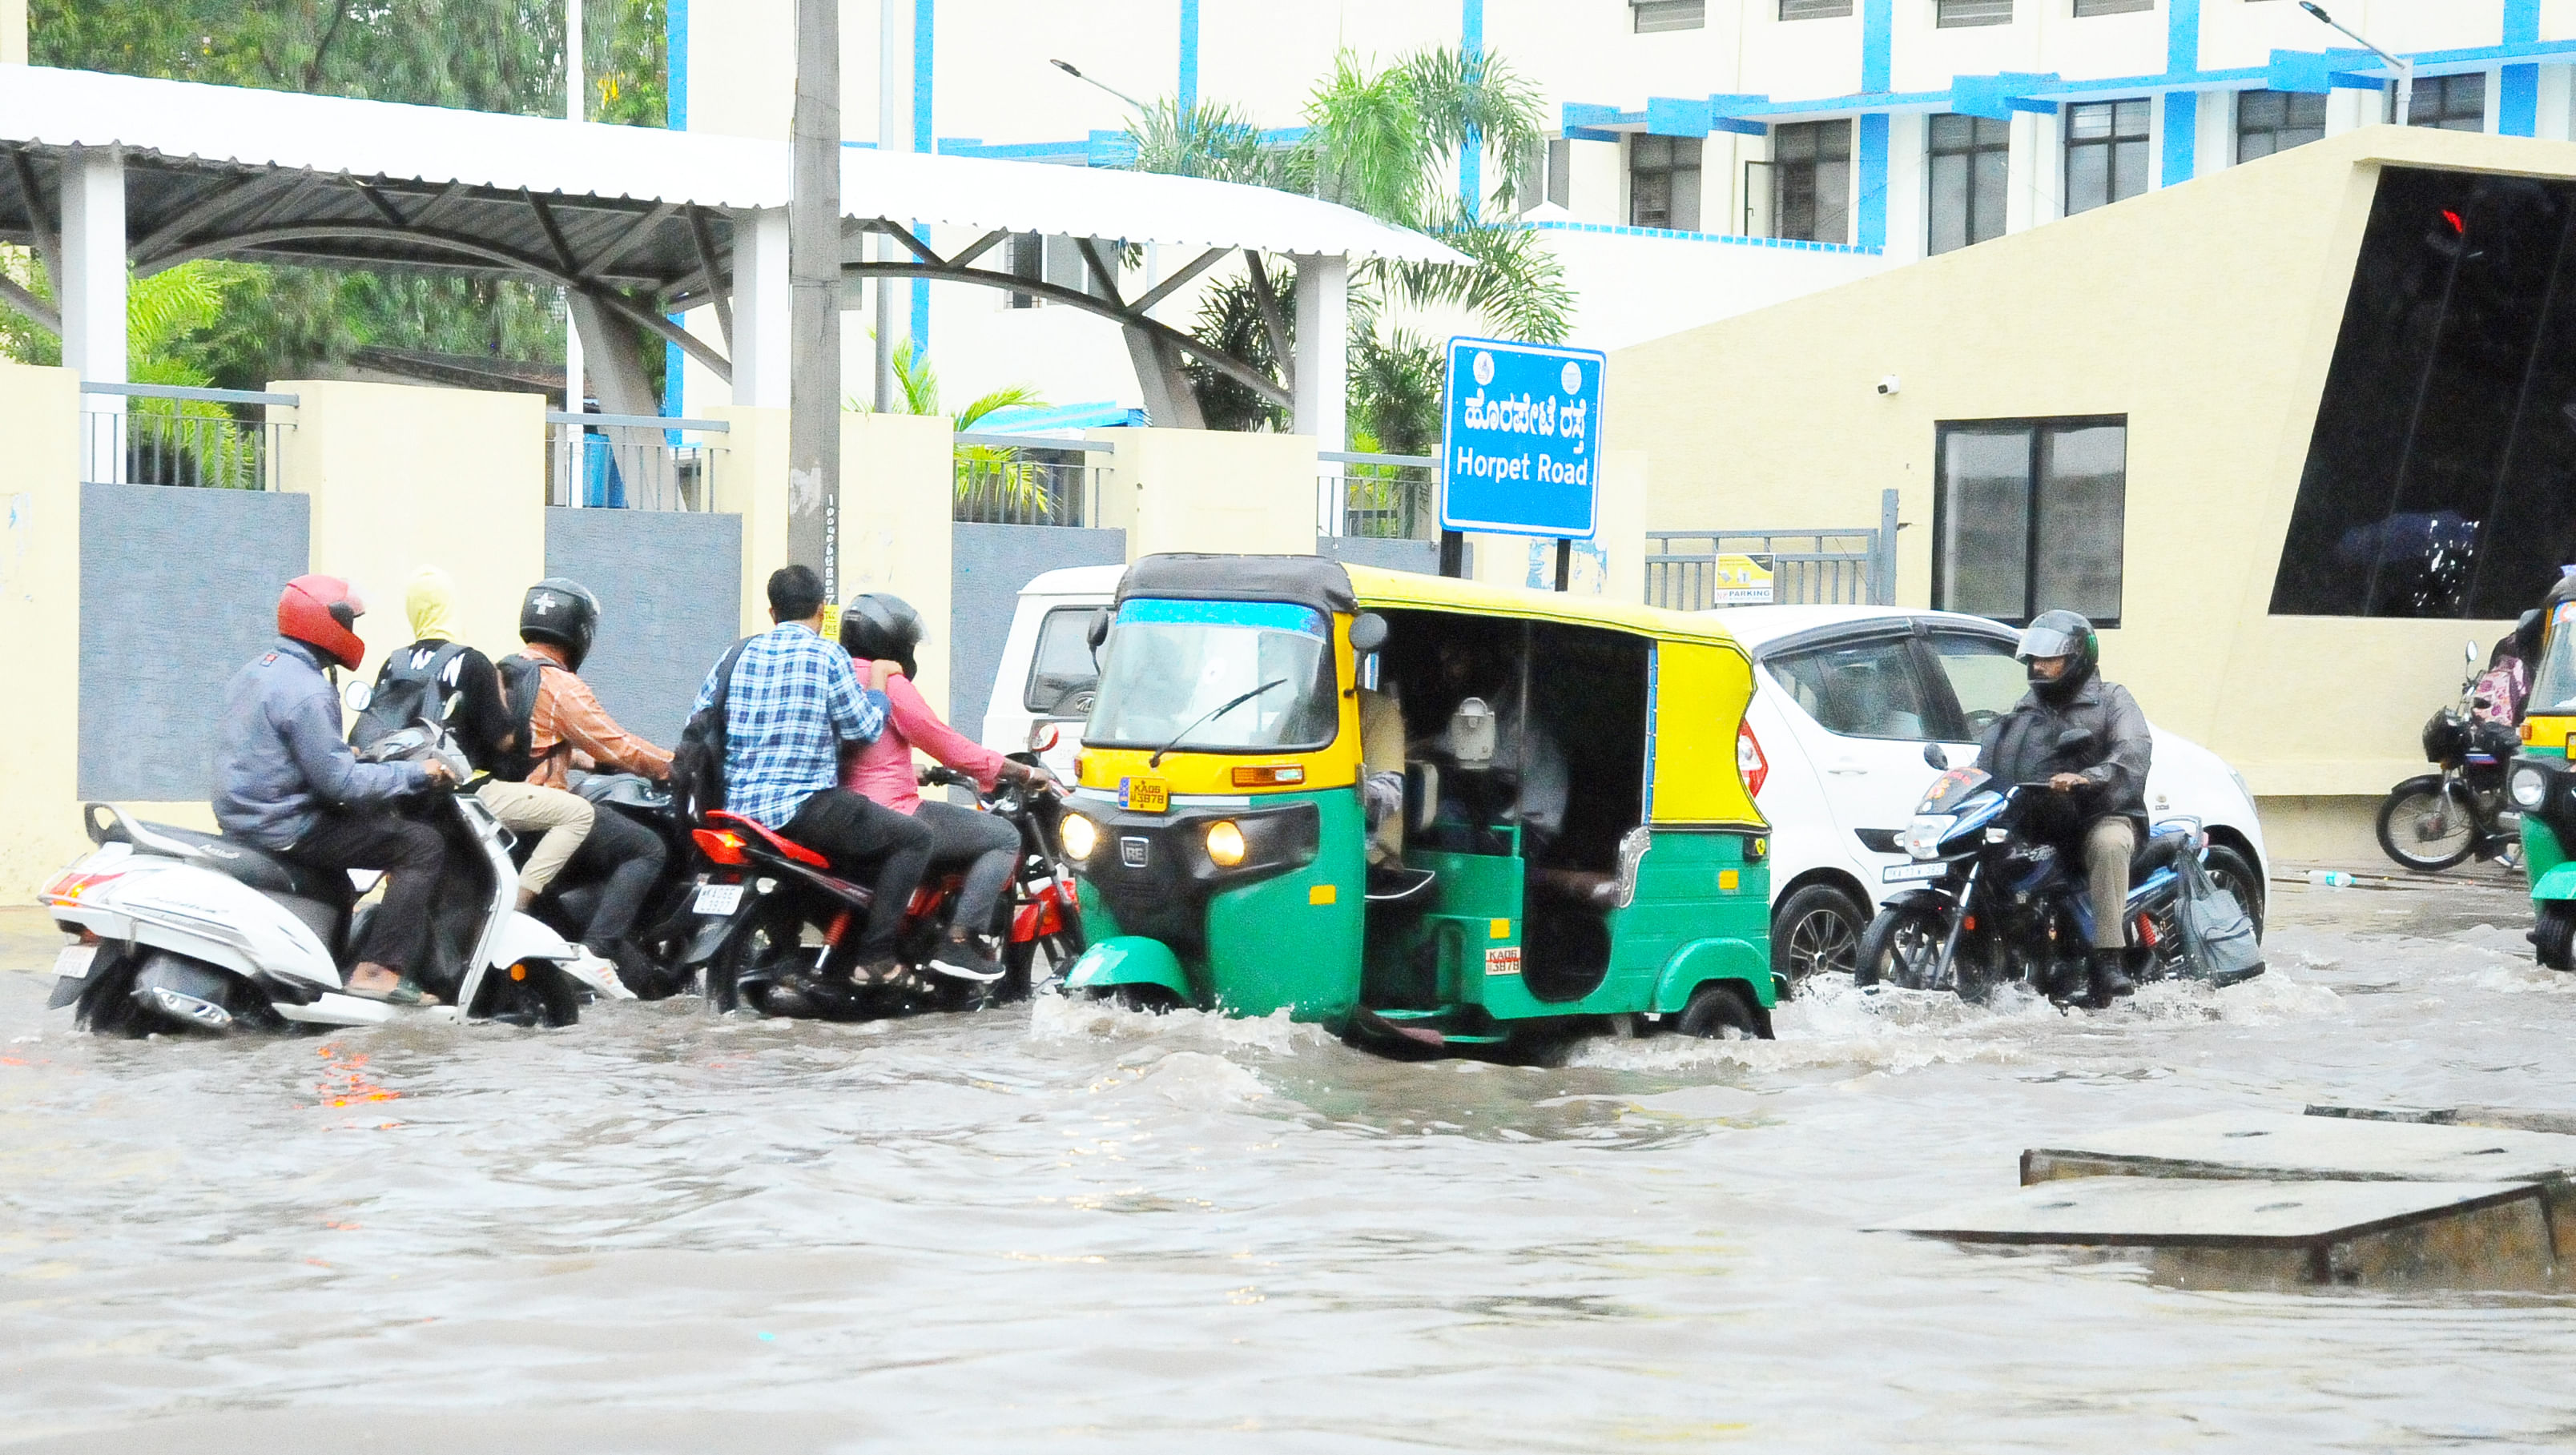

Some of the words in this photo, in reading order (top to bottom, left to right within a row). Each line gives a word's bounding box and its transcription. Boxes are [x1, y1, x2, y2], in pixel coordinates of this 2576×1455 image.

[1464, 388, 1556, 436] ಹೊರಪೇಟೆ
[1560, 398, 1588, 455] ರಸ್ತೆ
[1457, 446, 1531, 483] Horpet
[1537, 454, 1588, 485] Road
[1489, 950, 1517, 960] KA06
